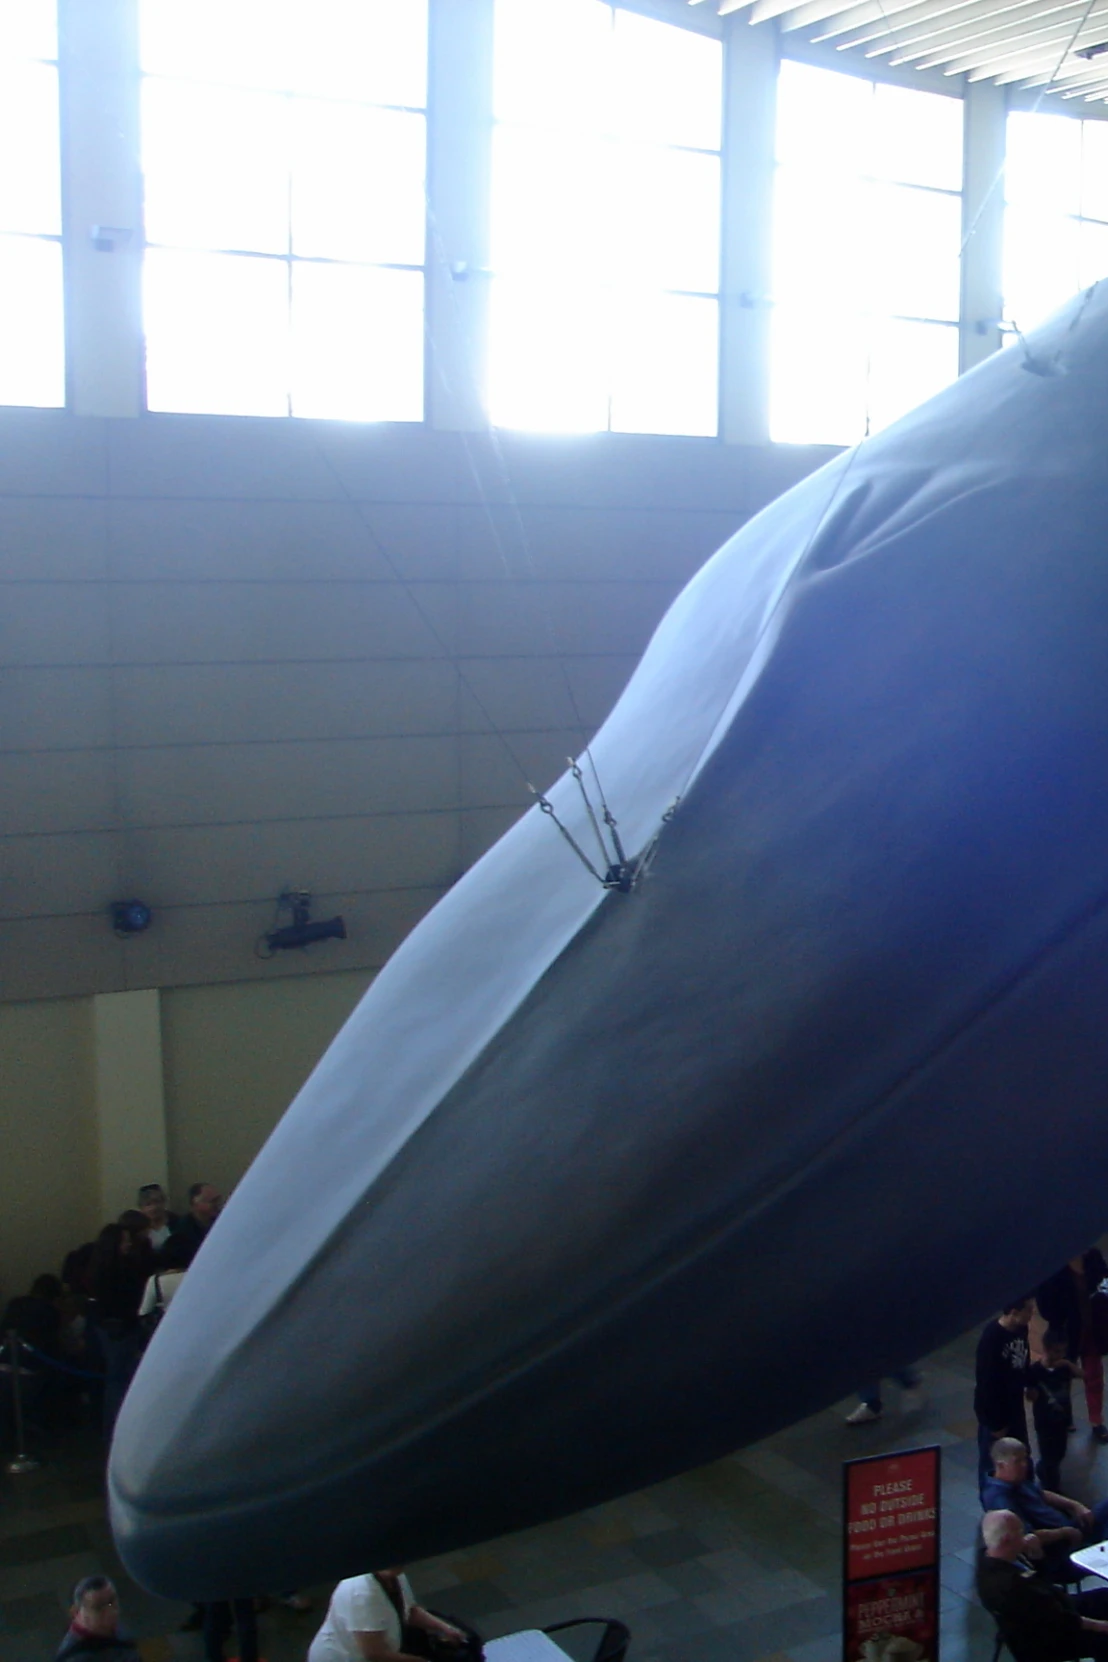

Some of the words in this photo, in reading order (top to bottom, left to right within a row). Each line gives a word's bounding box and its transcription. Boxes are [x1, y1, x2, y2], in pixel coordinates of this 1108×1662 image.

[873, 1479, 913, 1496] PLEASE
[861, 1502, 877, 1515] NO
[879, 1493, 925, 1512] OUTSIDE
[848, 1519, 877, 1534] FOOD
[879, 1515, 896, 1528] OR
[897, 1507, 937, 1525] DRINKS
